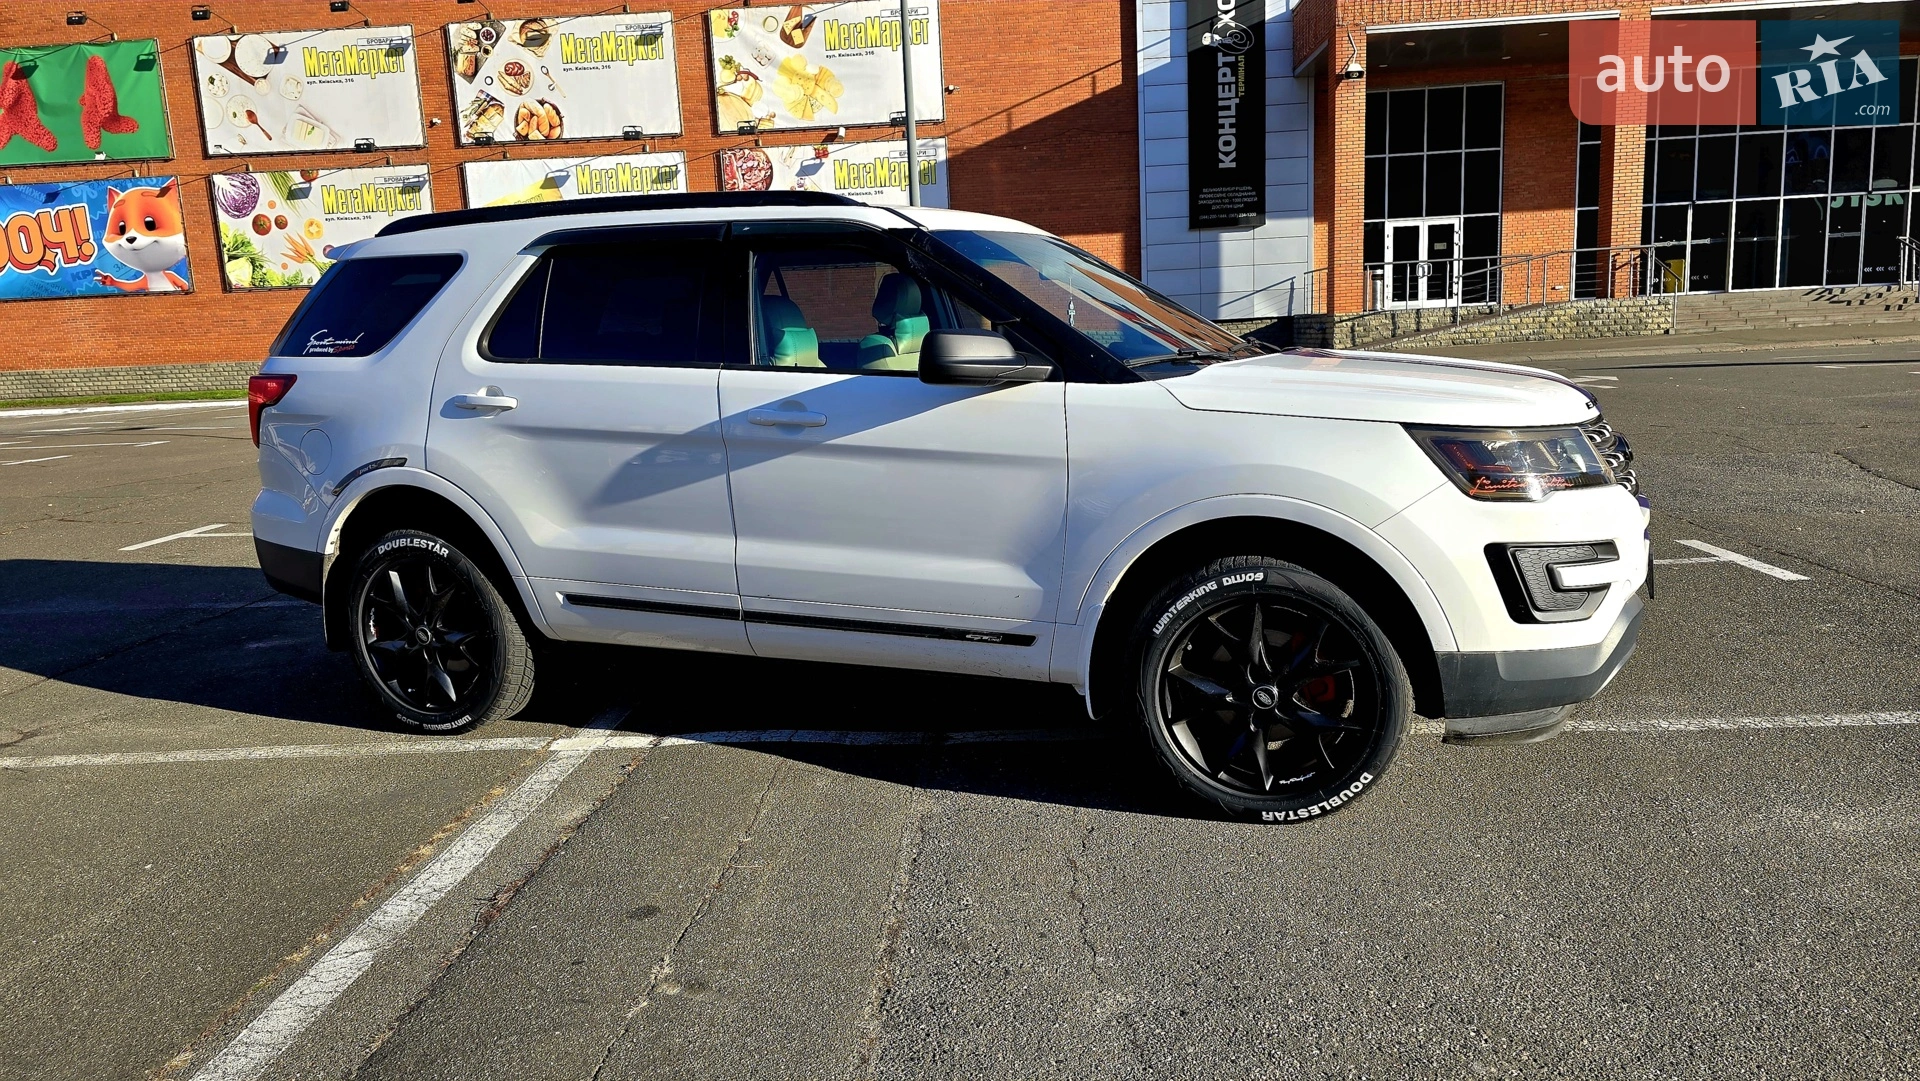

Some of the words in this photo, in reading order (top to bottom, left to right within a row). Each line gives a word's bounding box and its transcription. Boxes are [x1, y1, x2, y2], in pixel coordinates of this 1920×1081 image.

[560, 31, 664, 66] МегаМаркет
[824, 16, 929, 52] МегаМарет
[302, 45, 405, 79] МегаМаркет
[1218, 52, 1239, 168] КОНЦЕРТ
[576, 163, 678, 195] МегаМаркет
[834, 157, 937, 191] МегаМарет
[321, 183, 421, 216] МегаМаркет
[0, 206, 95, 271] ОЧ!
[377, 538, 449, 558] DOUBLESTAR
[1152, 580, 1218, 635] WINTERKING
[1261, 772, 1374, 822] DOUBLESTAR
